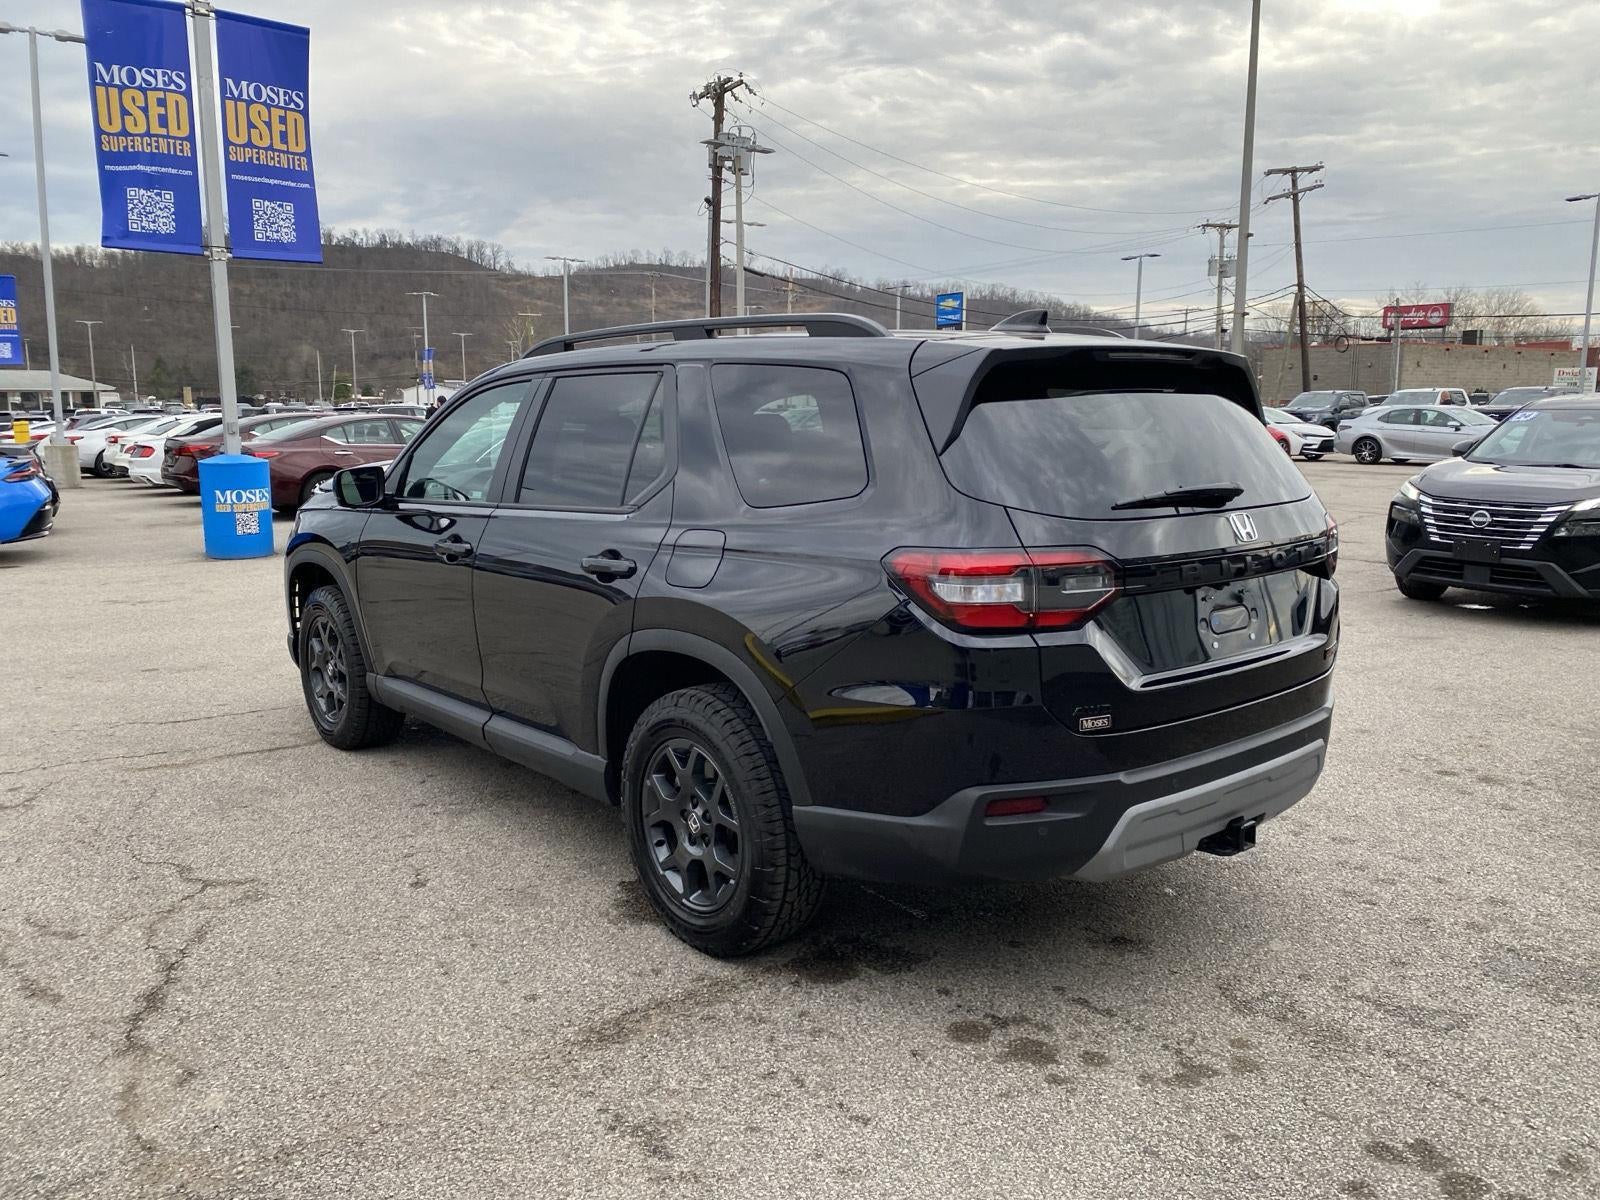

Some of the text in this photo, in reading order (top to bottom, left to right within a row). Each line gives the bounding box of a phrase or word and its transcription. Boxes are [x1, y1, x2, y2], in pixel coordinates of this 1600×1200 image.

[94, 62, 186, 92] MOSES
[224, 77, 305, 111] MOSES
[95, 85, 190, 138] USED
[225, 99, 307, 154] USED
[100, 134, 192, 157] SUPERCENTER
[228, 145, 309, 172] SUPERCENTER
[104, 164, 193, 177] mosesusedsupercenter.com
[214, 488, 269, 504] MOSES
[1082, 718, 1108, 730] MOSES
